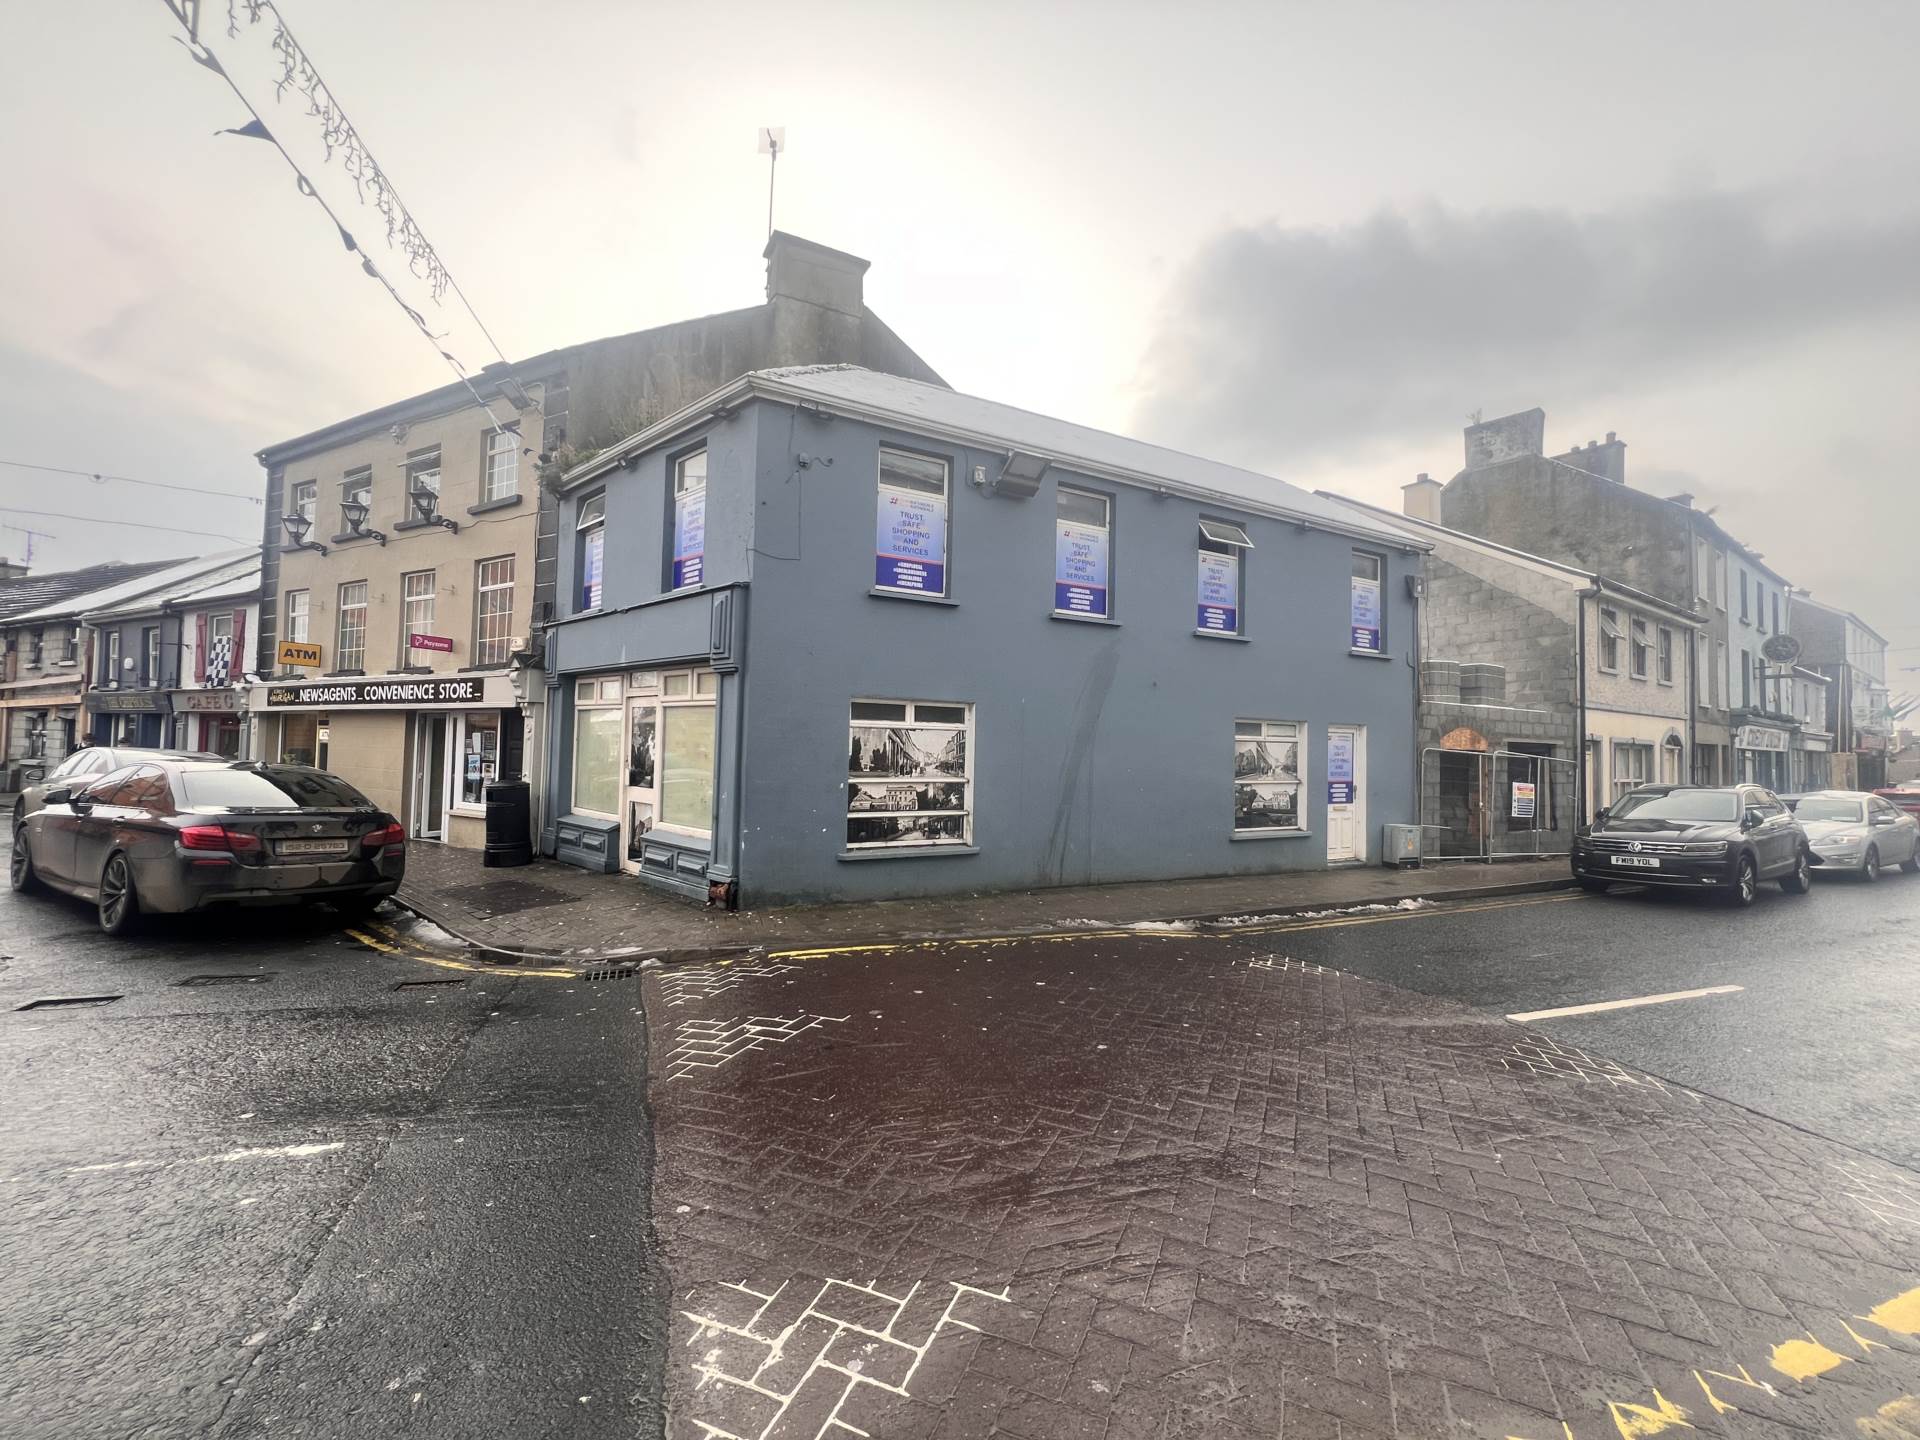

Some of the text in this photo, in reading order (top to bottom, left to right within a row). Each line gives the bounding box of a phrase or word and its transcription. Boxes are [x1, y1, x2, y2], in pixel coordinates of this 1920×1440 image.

[892, 527, 930, 539] SHOPPING
[903, 538, 919, 546] AND
[892, 544, 929, 556] SERVICES
[1066, 572, 1095, 581] SERVICES
[423, 640, 449, 648] Payzone
[283, 648, 317, 660] ATM
[299, 686, 357, 701] NEWSAGENTS
[364, 684, 435, 700] CONVENIENCE
[439, 682, 473, 699] STORE
[1615, 856, 1634, 864] FM19
